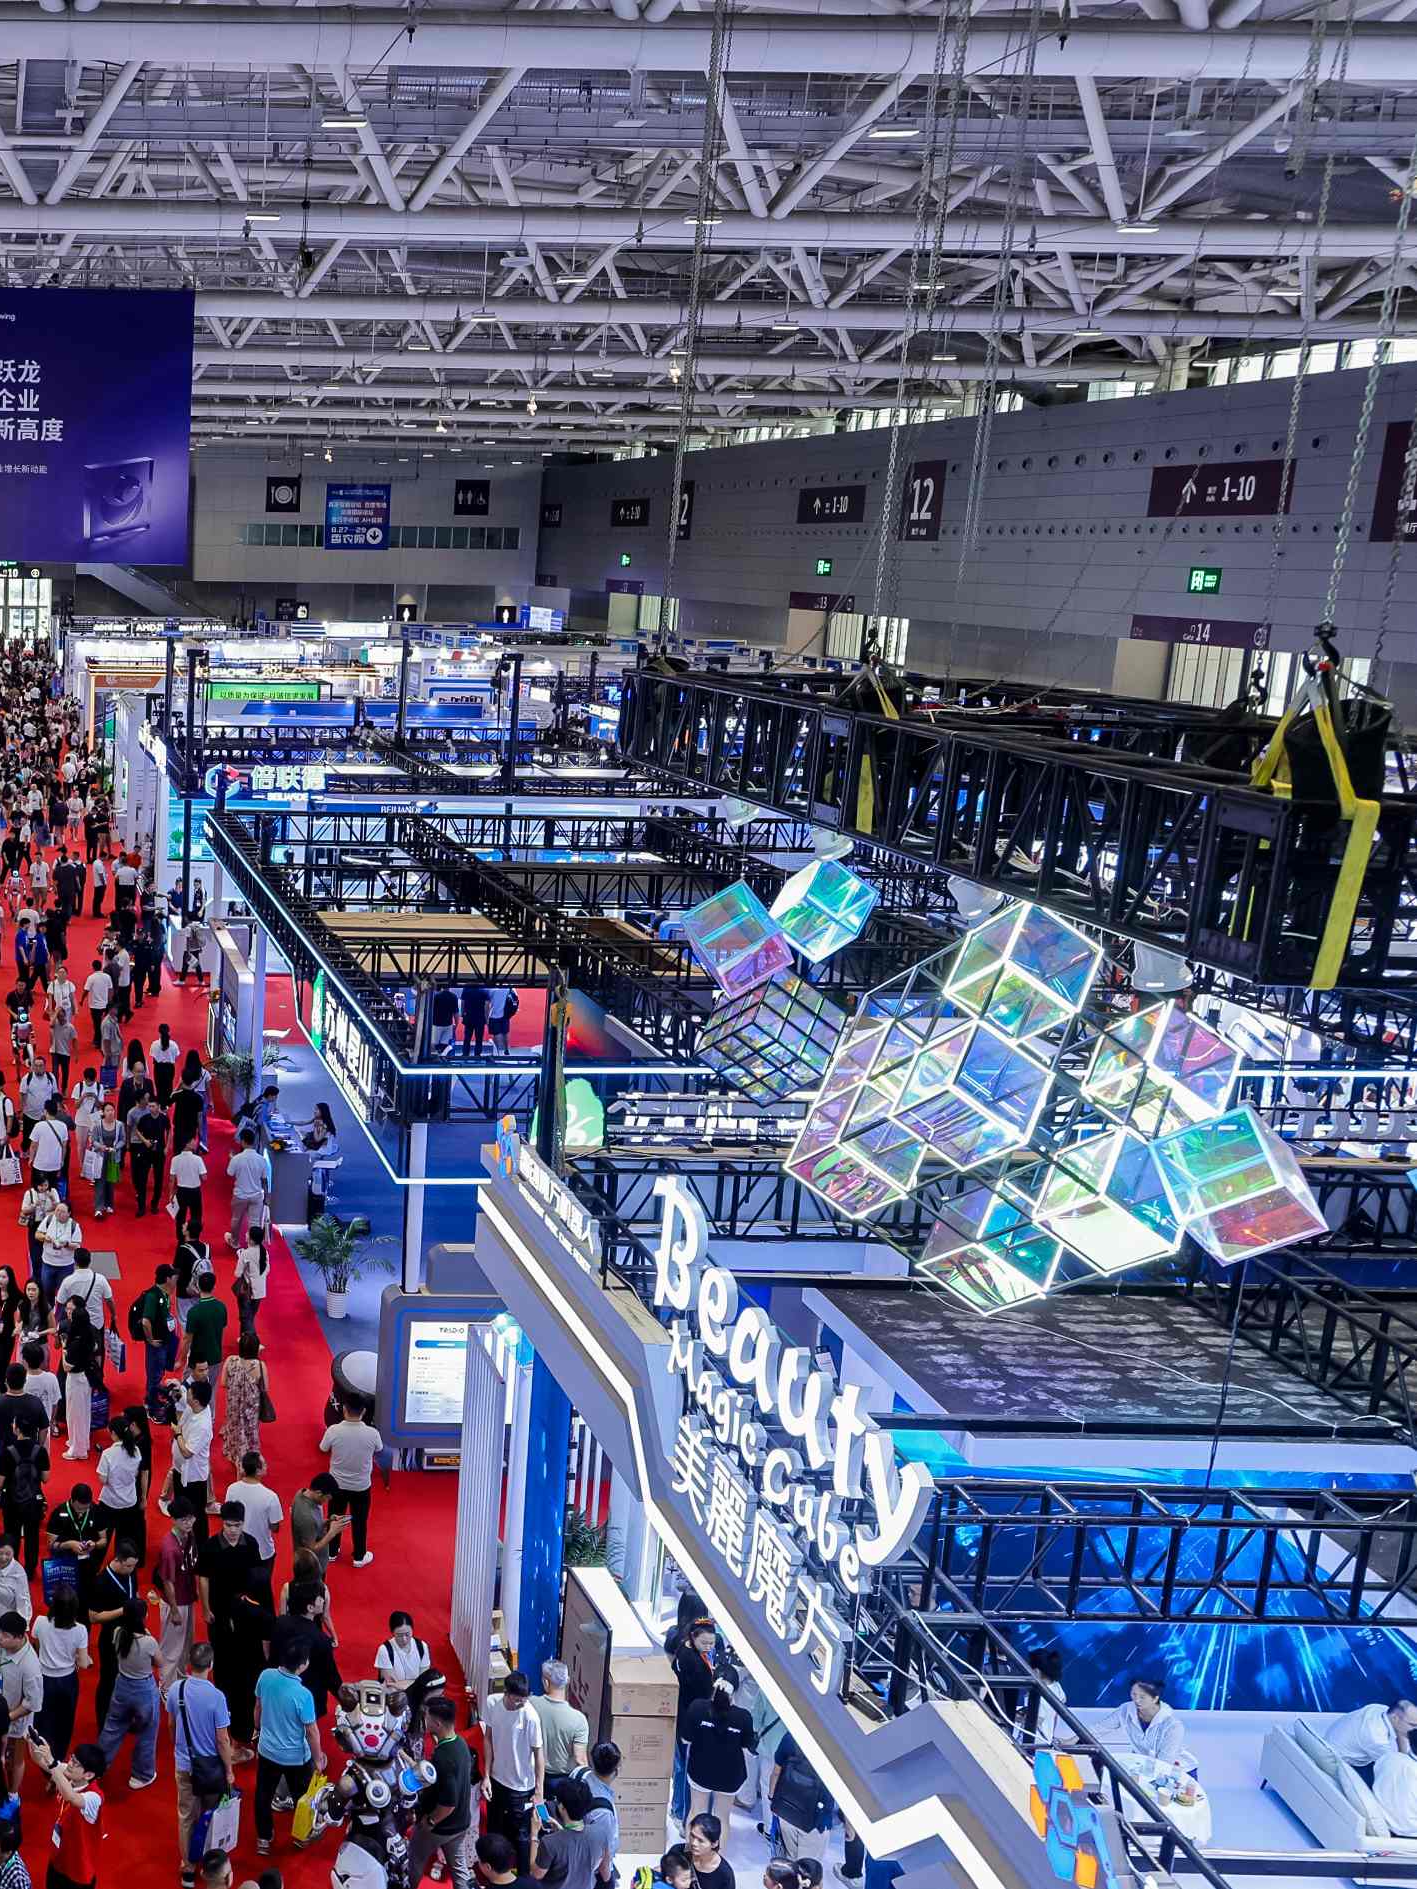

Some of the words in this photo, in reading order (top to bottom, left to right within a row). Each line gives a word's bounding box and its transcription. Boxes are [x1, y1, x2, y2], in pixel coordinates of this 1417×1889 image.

[910, 478, 934, 520] 12
[1221, 475, 1256, 502] 1-10
[1196, 623, 1211, 642] 14
[652, 1175, 923, 1567] Beauty
[666, 1319, 763, 1466] Magic
[762, 1447, 862, 1594] Cube
[671, 1416, 838, 1697] 美麗魔方
